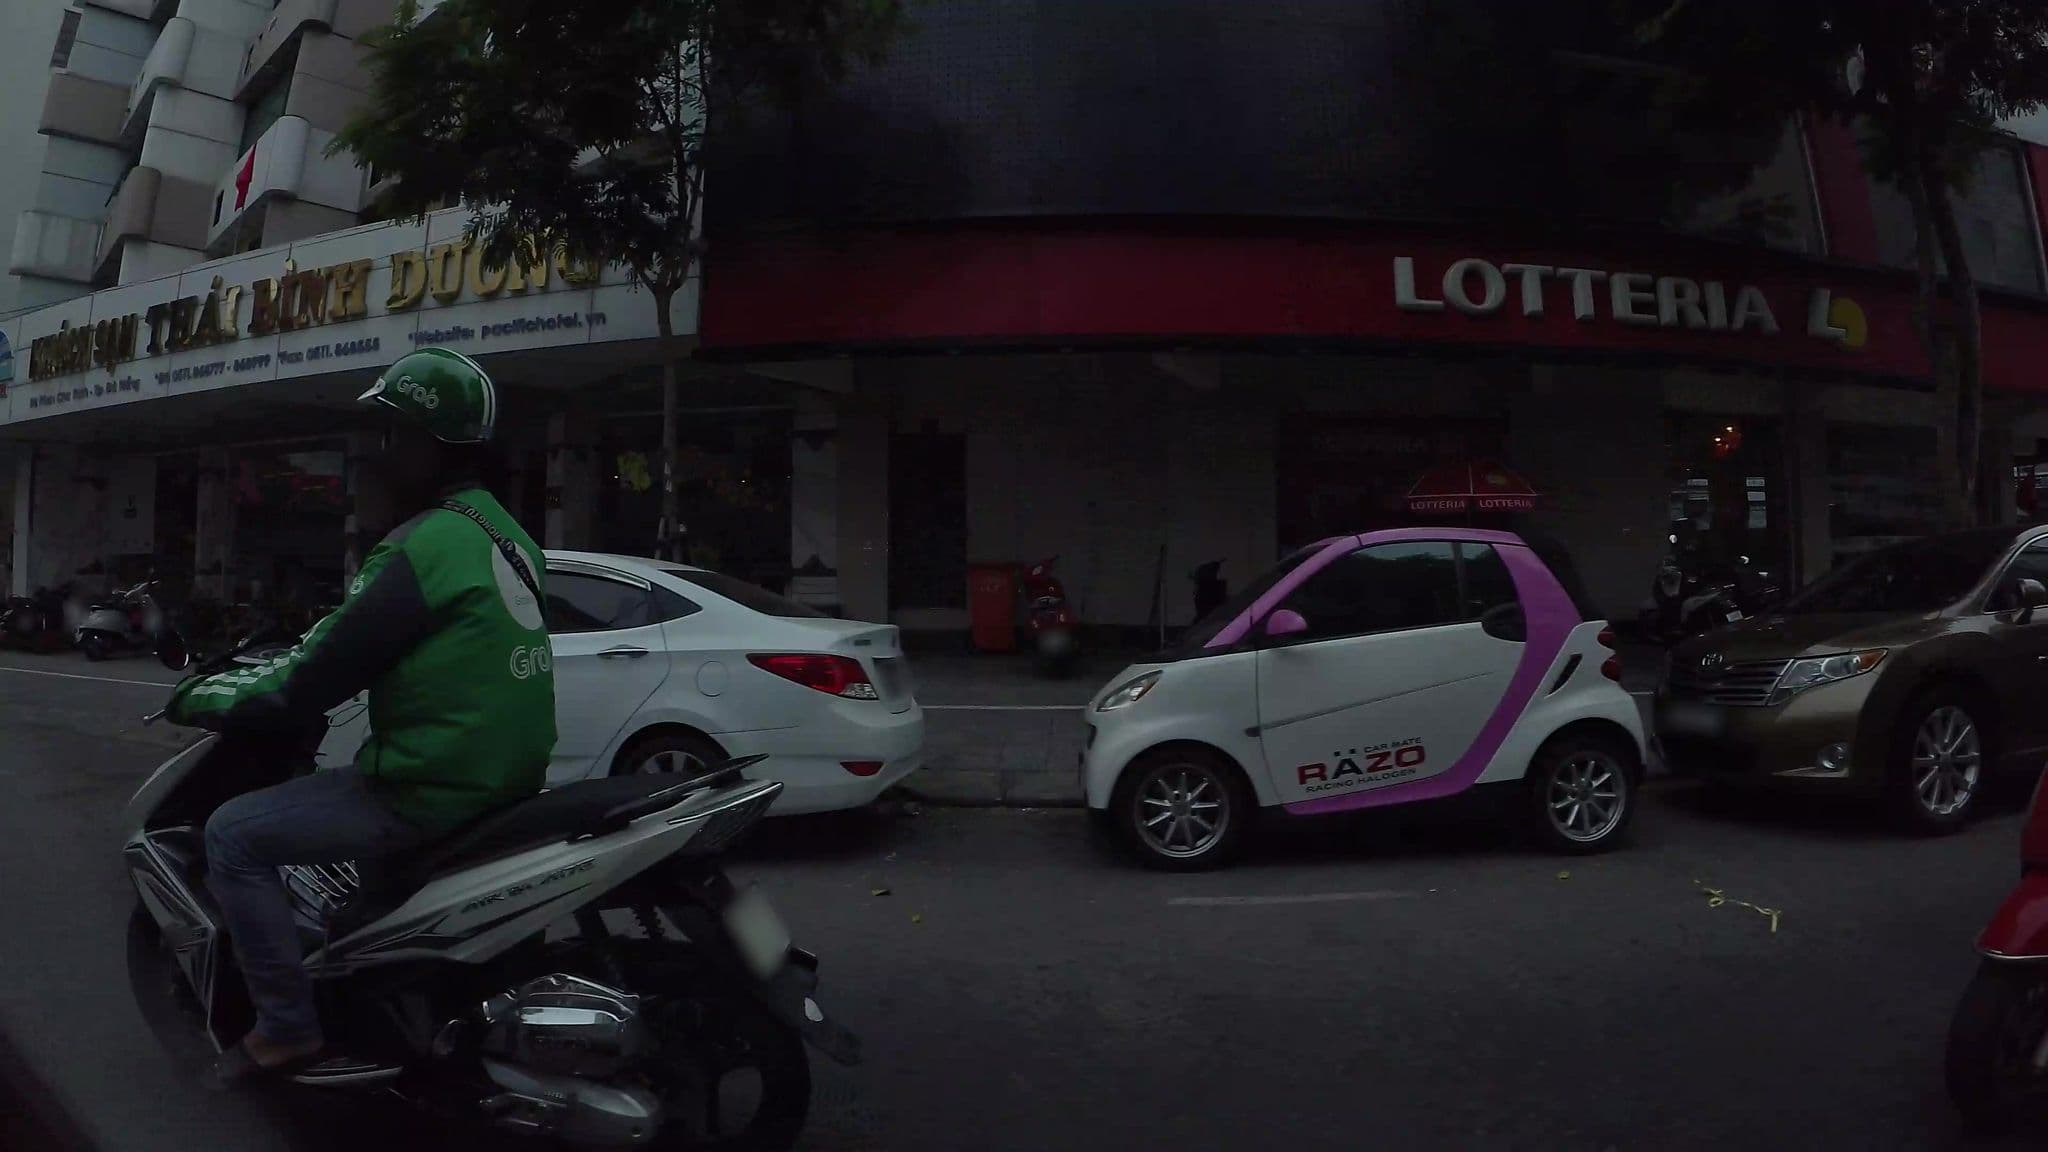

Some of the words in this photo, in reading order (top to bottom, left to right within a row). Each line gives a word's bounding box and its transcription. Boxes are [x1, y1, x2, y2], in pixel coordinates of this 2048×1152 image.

[1393, 256, 1781, 334] LOTTERIA
[396, 374, 440, 411] Grab
[1410, 500, 1466, 512] LOTTERIA
[1479, 498, 1536, 510] LOTTERIA
[1363, 743, 1388, 754] CAR
[1391, 736, 1422, 749] MATE
[1305, 779, 1354, 794] RACING
[1357, 767, 1417, 785] HALOGEN
